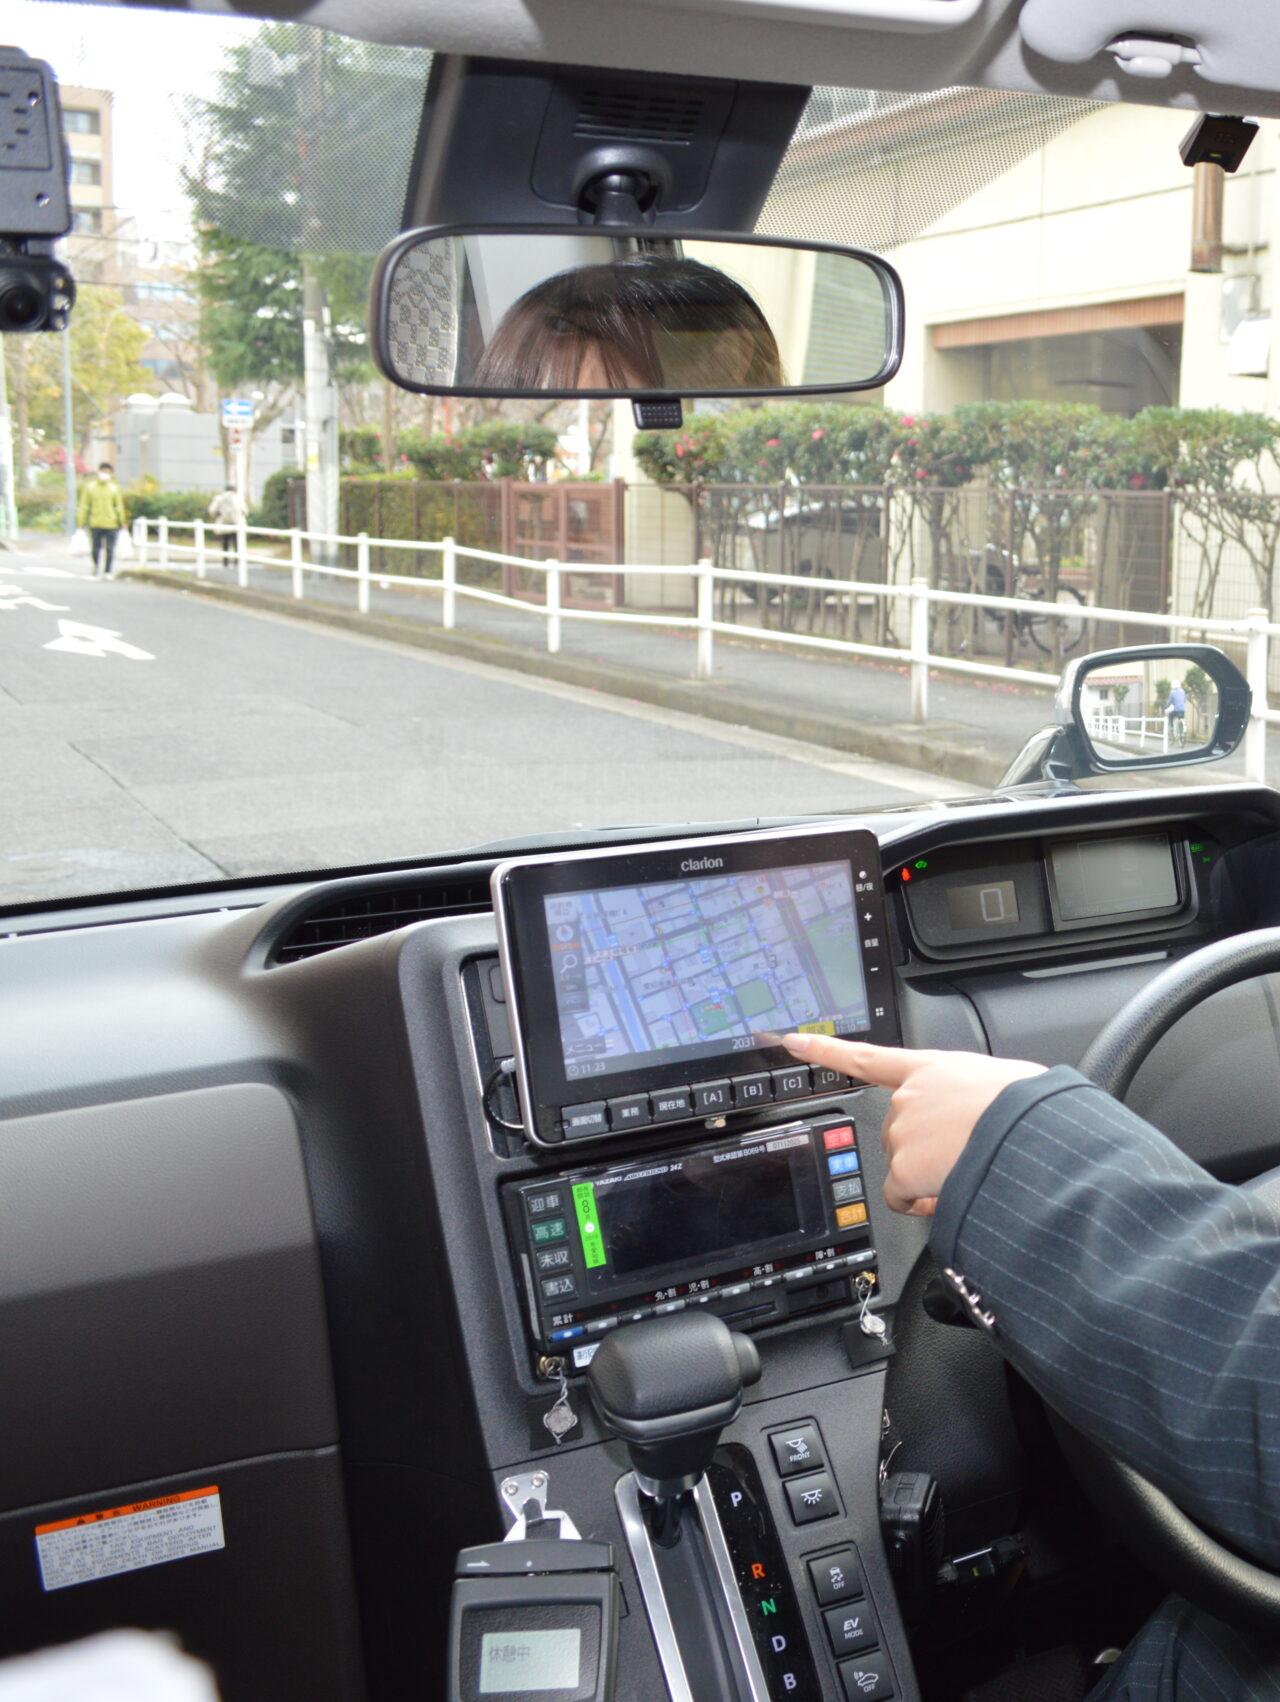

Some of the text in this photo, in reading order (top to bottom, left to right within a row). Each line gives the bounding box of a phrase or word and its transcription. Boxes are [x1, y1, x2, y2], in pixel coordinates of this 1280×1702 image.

[681, 856, 724, 872] clarion
[566, 1042, 603, 1056] メニュー
[658, 1099, 686, 1112] 現在地
[829, 1129, 850, 1146] 空車
[596, 1176, 622, 1186] YAZAKI
[837, 1183, 860, 1197] 支払
[530, 1194, 559, 1213] 迎車
[841, 1207, 863, 1223] 合計
[534, 1222, 564, 1240] 高速
[540, 1250, 569, 1268] 未収
[543, 1278, 574, 1297] 書込
[552, 1313, 574, 1327] 累計
[789, 1450, 811, 1462] FRONT
[132, 1495, 181, 1513] WARNING
[731, 1491, 742, 1507] P
[751, 1563, 766, 1580] R
[833, 1581, 845, 1590] OFF
[761, 1598, 777, 1616] N
[843, 1617, 859, 1632] EV
[844, 1629, 864, 1639] MODE
[772, 1635, 786, 1653] D
[783, 1673, 797, 1690] B
[863, 1684, 876, 1693] OFF
